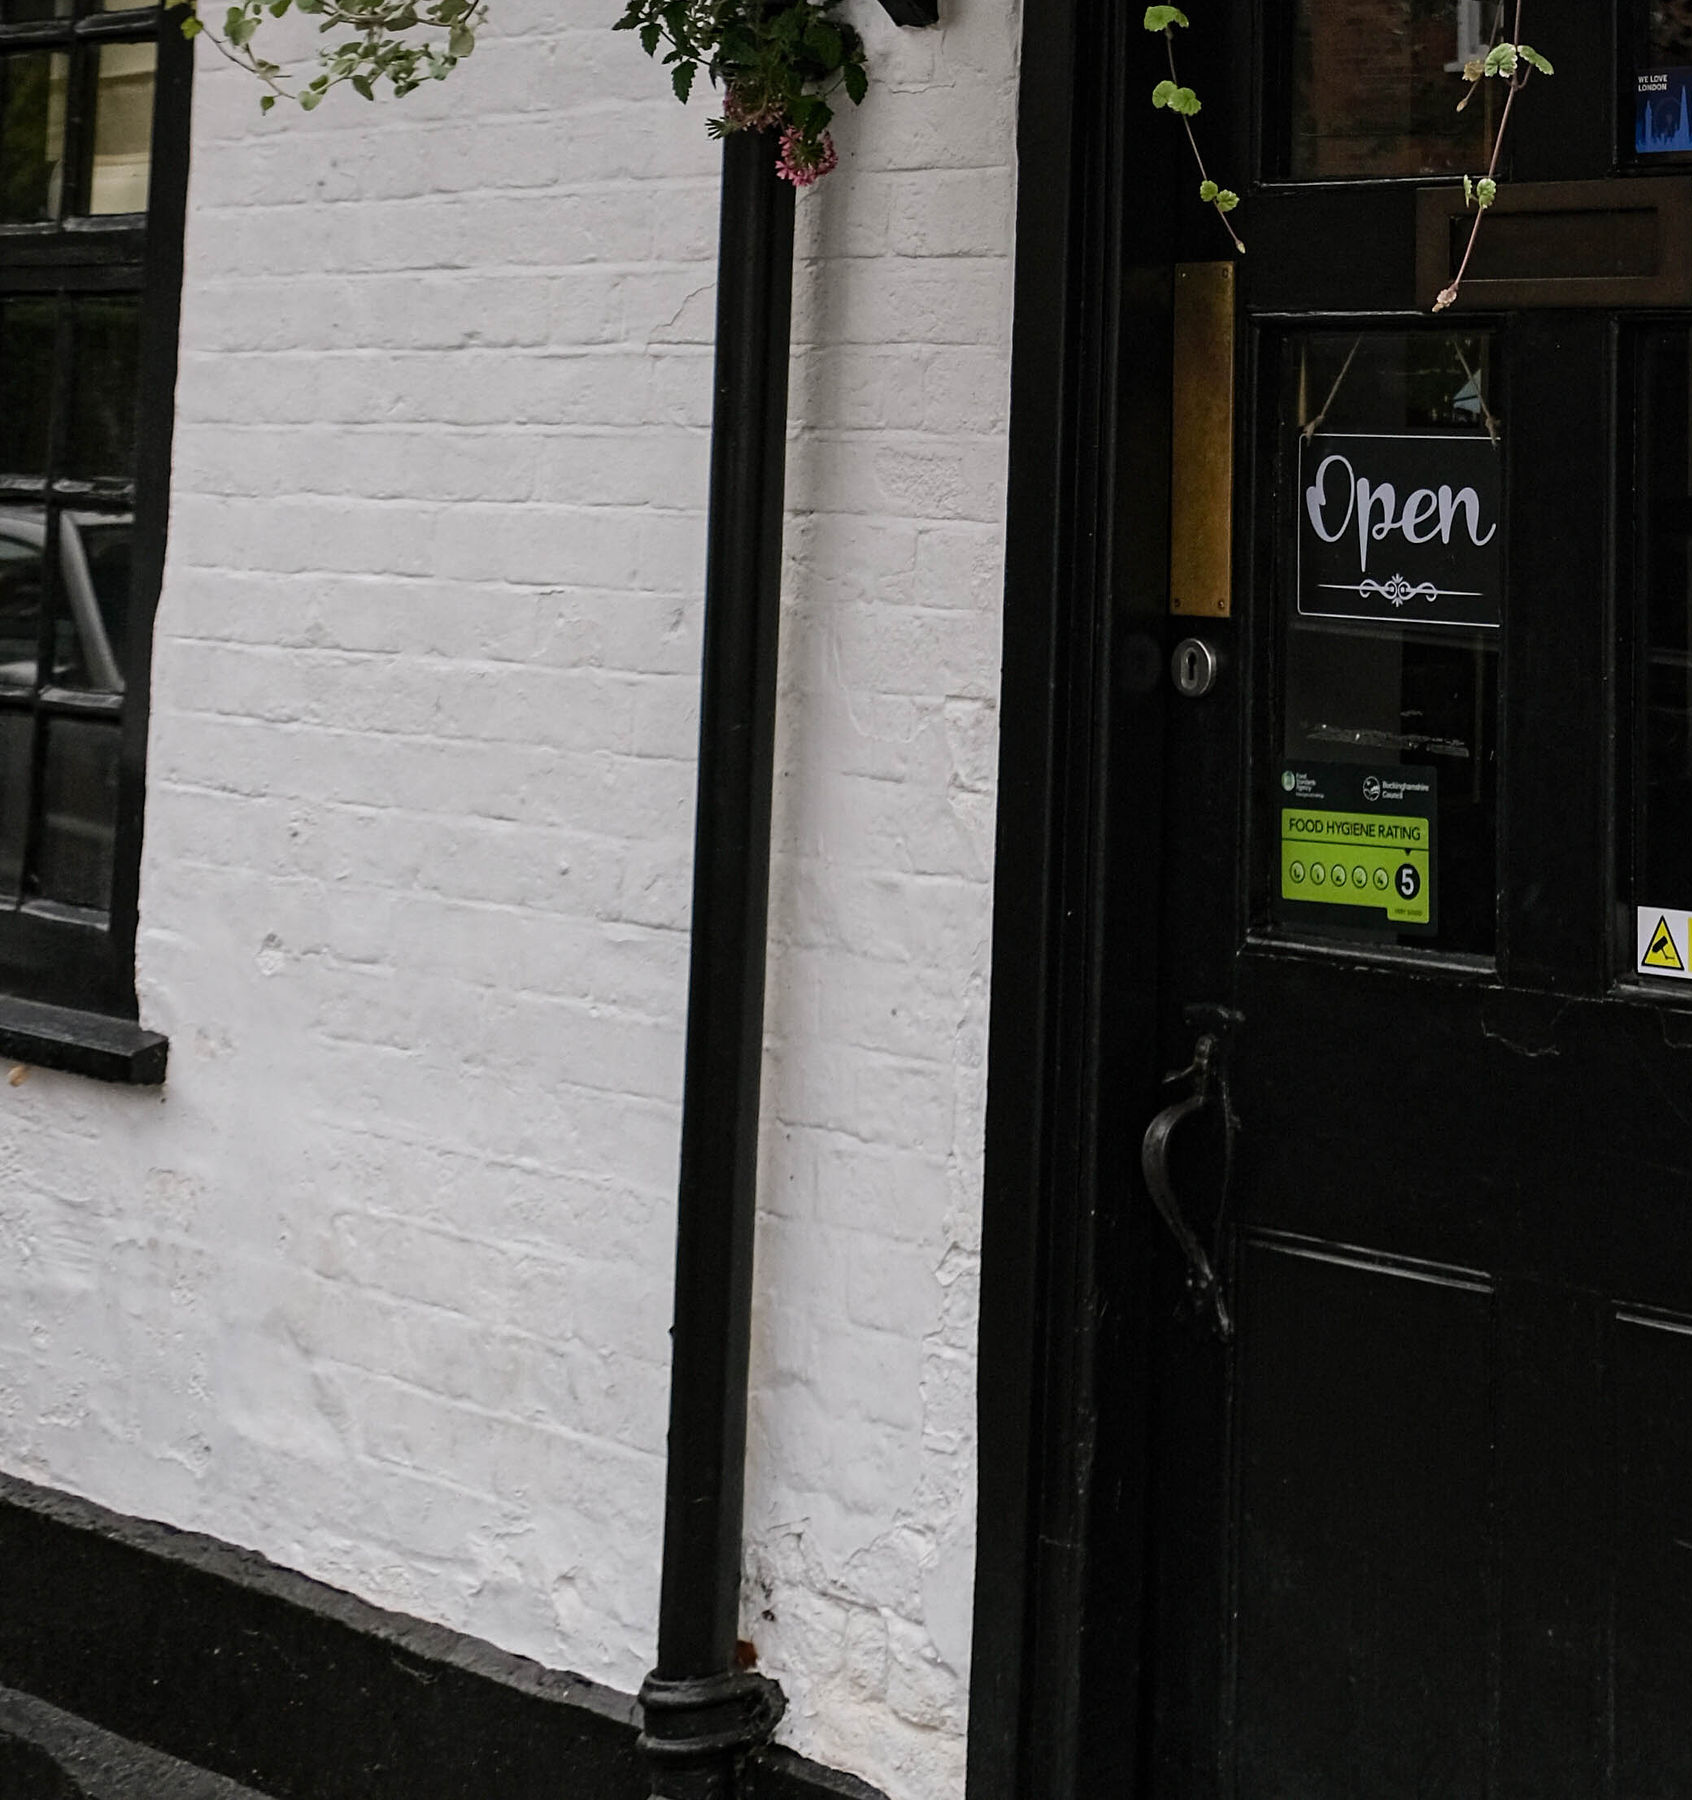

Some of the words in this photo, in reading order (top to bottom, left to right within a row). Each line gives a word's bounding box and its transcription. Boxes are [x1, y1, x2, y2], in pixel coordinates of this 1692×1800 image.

[1638, 83, 1667, 92] LONDON
[1650, 74, 1668, 82] LOVE
[1305, 454, 1497, 573] Open
[1289, 818, 1323, 833] FOOD
[1327, 821, 1375, 838] HYGIENE
[1378, 824, 1421, 841] RATING
[1401, 868, 1415, 896] 5
